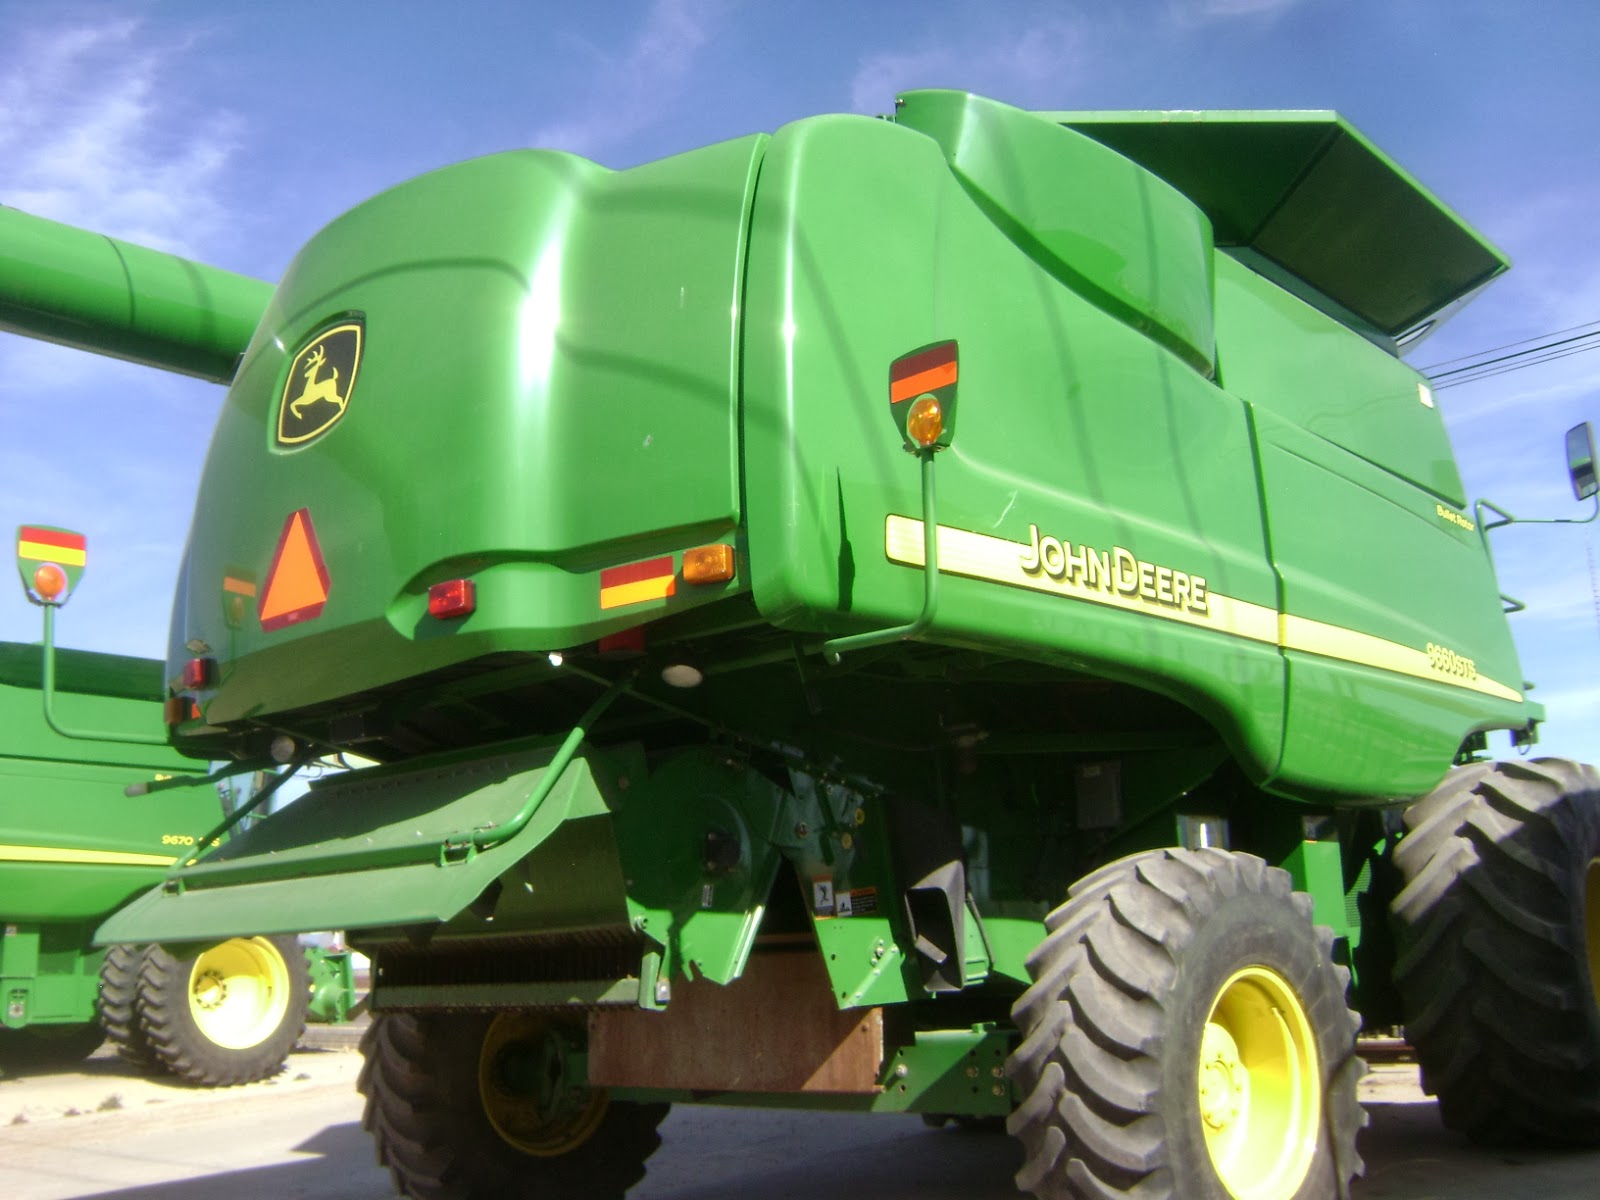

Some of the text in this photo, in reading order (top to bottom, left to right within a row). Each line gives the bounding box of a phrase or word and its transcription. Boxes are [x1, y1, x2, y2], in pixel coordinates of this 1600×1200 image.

[1020, 523, 1209, 617] JOHN DEERE
[161, 834, 194, 846] 9670
